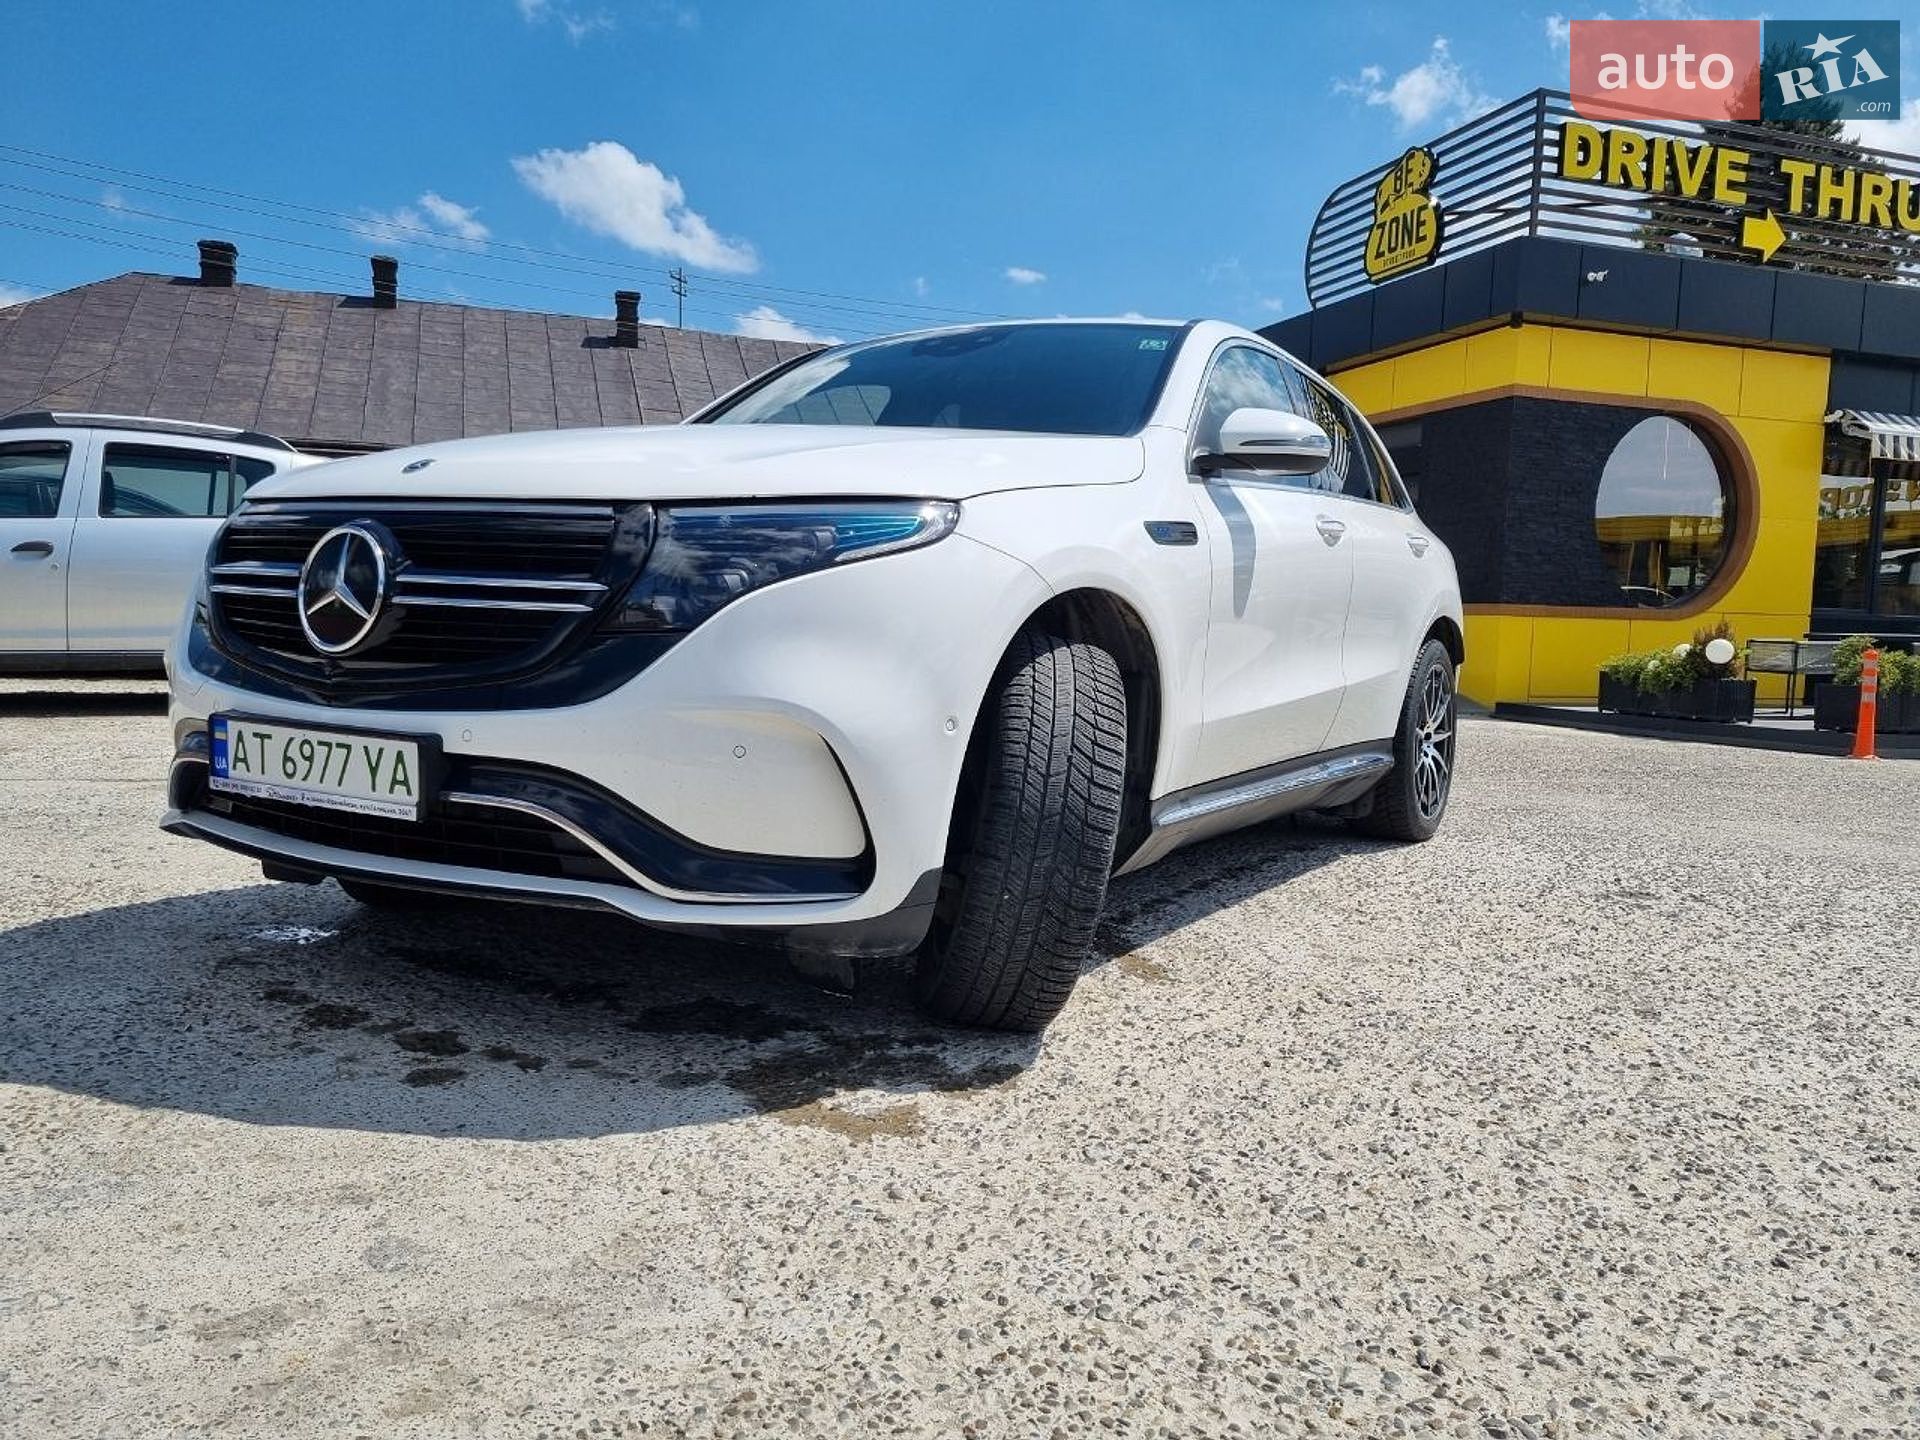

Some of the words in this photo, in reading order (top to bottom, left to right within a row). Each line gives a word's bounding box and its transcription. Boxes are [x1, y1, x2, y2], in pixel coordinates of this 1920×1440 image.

[1562, 121, 1751, 206] DRIVE
[1780, 159, 1920, 233] THRU
[1374, 203, 1429, 260] ZONE
[214, 757, 229, 770] UA
[232, 730, 273, 776] AT
[282, 736, 352, 788] 6977
[363, 745, 413, 797] YA
